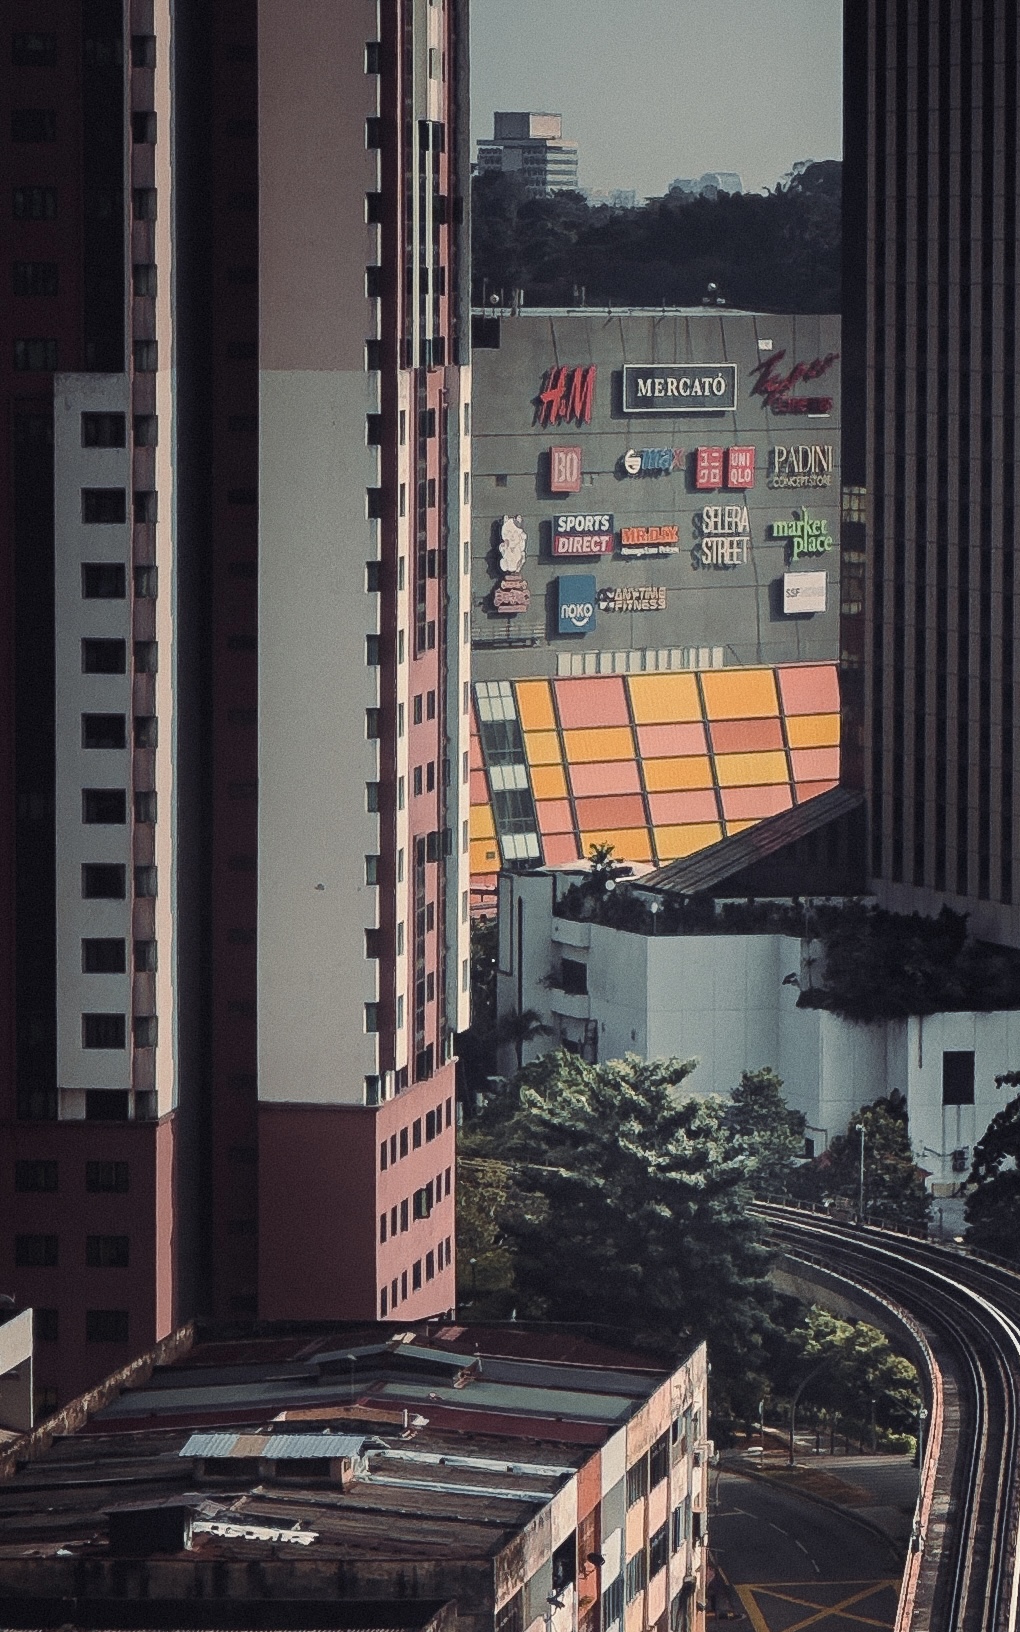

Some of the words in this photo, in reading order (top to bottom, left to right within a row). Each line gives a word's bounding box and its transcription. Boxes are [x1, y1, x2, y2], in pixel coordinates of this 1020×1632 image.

[540, 364, 597, 426] H&M
[636, 373, 726, 397] MERCATÓ
[731, 452, 750, 467] UNI
[774, 445, 833, 474] PADINI
[730, 468, 752, 484] QLO
[557, 515, 610, 533] SPORTS
[703, 505, 749, 534] SELERA
[773, 506, 828, 537] market
[557, 535, 610, 553] DIRECT
[702, 537, 750, 565] STREET
[792, 534, 833, 561] place
[615, 599, 666, 612] FITNESS
